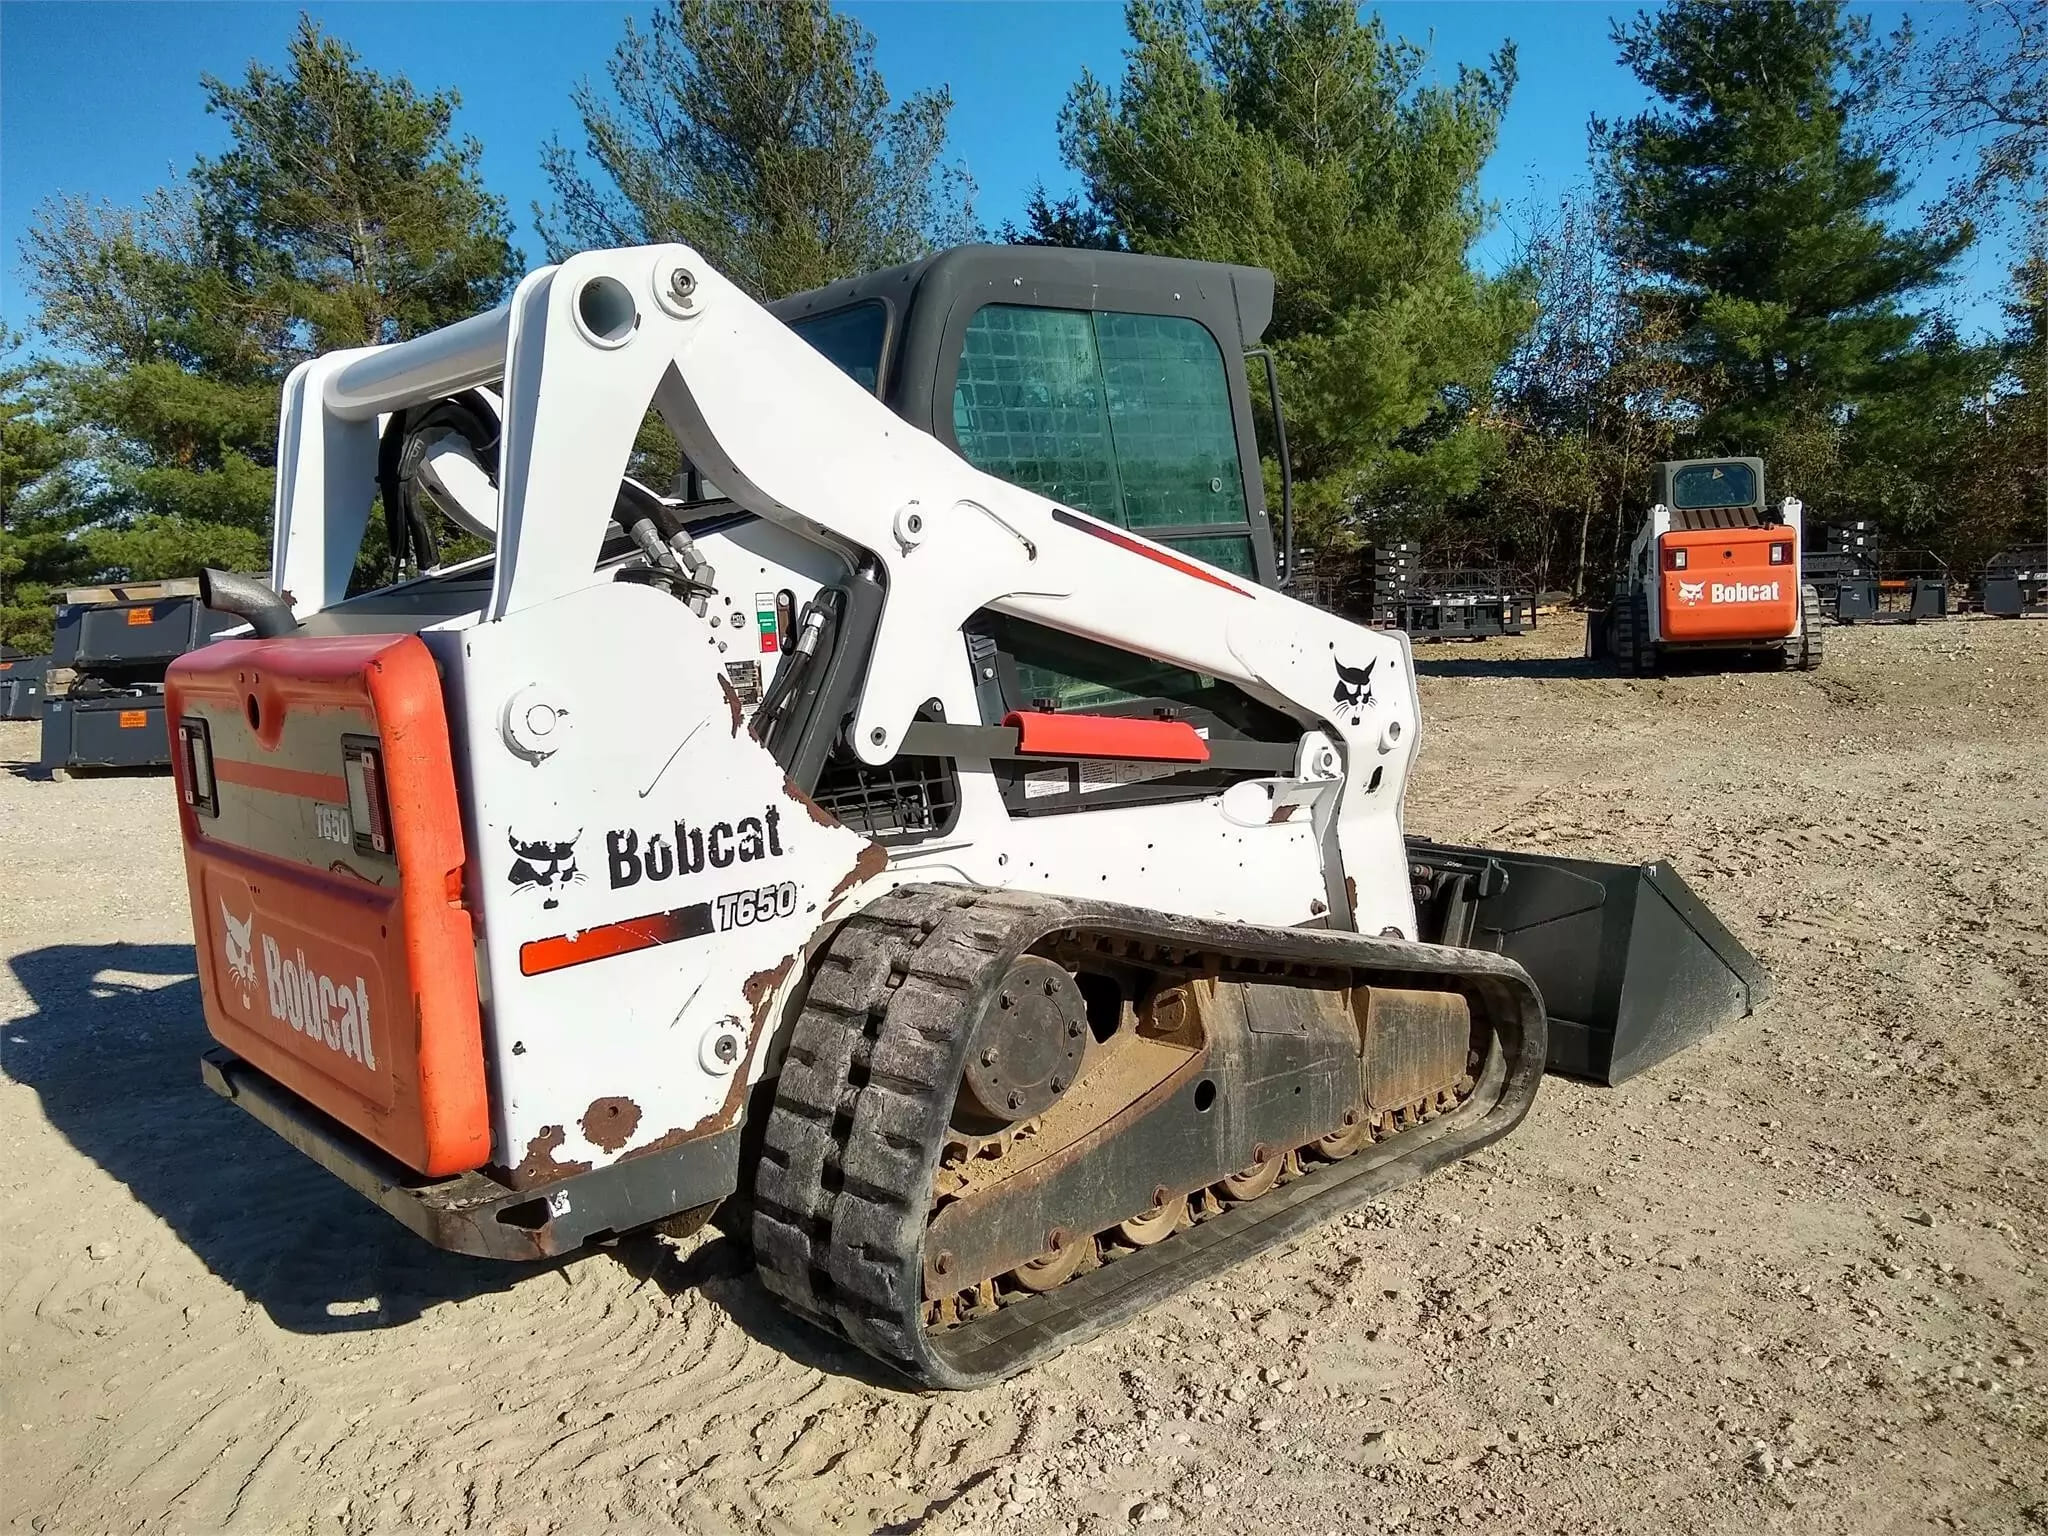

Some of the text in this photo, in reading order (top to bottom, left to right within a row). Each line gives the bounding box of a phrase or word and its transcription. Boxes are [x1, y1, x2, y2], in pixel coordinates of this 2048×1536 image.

[1711, 581, 1779, 603] Bobcat
[315, 806, 350, 844] T650
[606, 804, 783, 890] Bobcat
[716, 880, 797, 932] T650
[262, 933, 376, 1071] Bobcat
